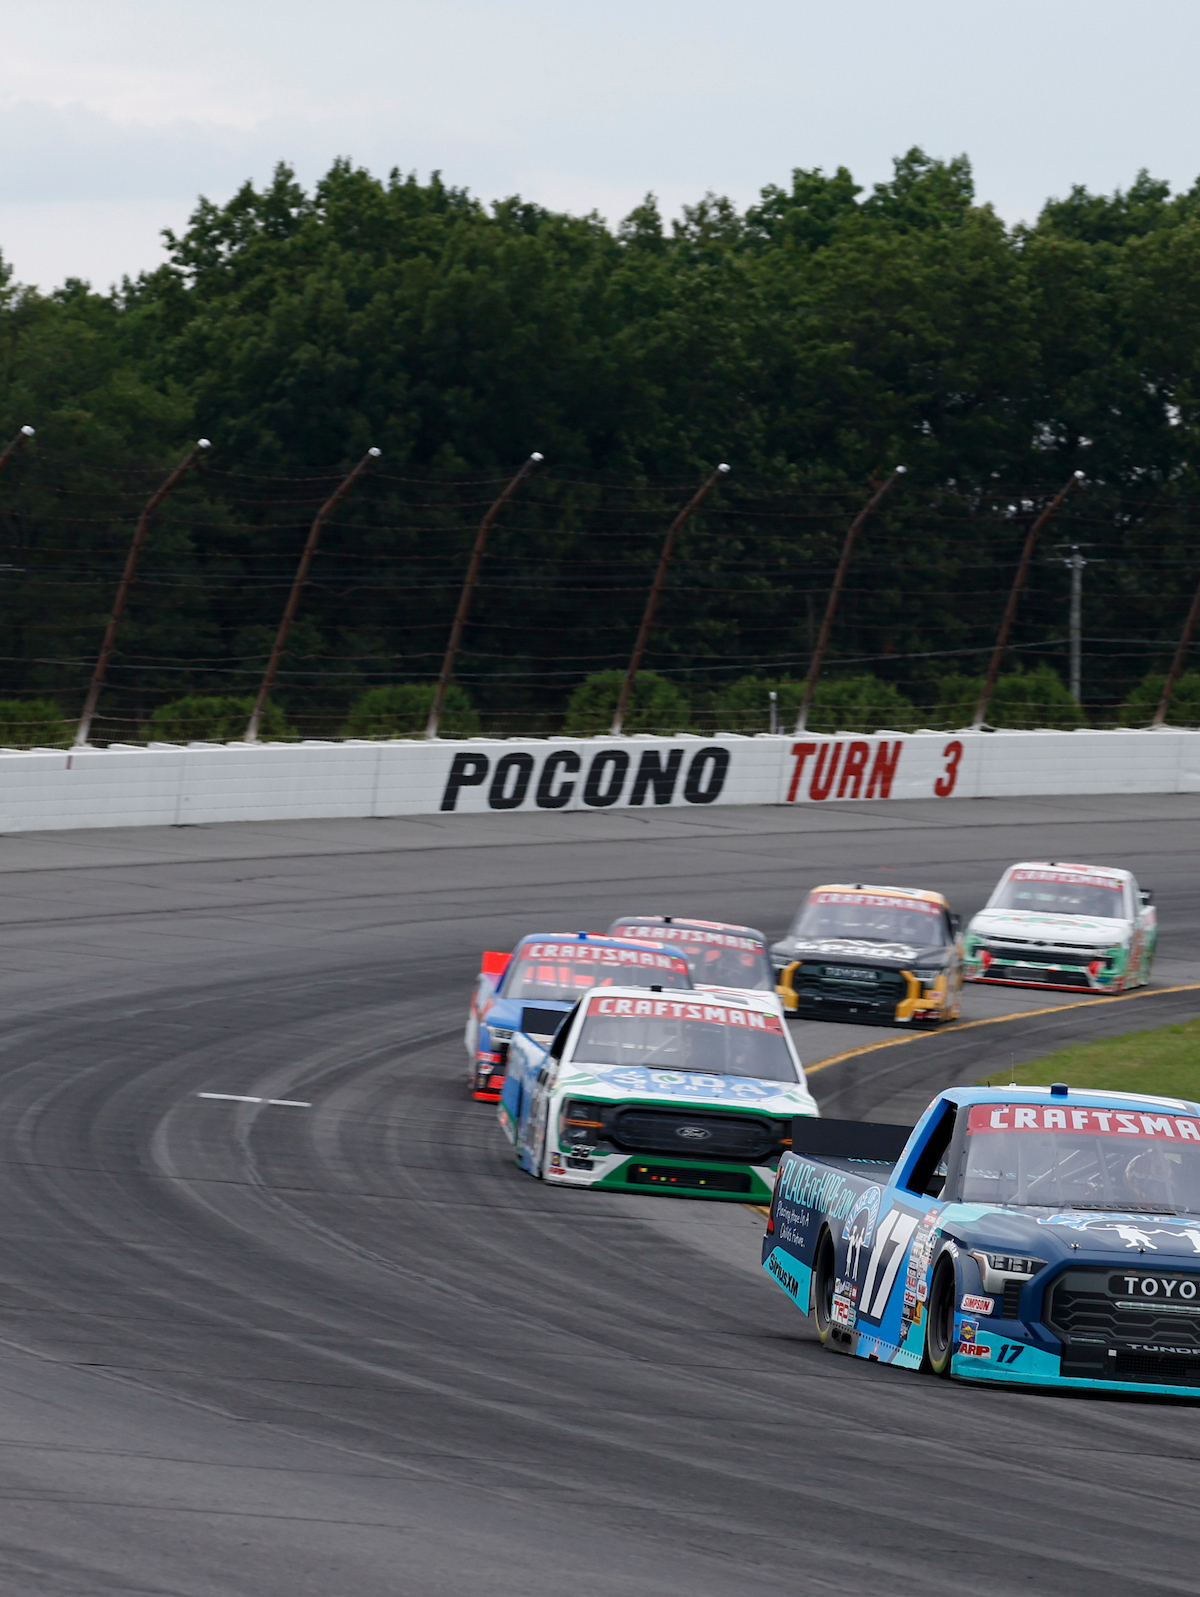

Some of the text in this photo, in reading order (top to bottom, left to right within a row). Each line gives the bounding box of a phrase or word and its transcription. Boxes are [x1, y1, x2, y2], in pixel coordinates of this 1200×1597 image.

[440, 740, 963, 811] POCONO TURN 3
[623, 926, 757, 951] CRAFTSMAN
[529, 943, 672, 969] CRAFTSMAN
[599, 998, 766, 1029] CRAFTSMAN
[769, 1253, 799, 1298] SiriusXM
[859, 1209, 919, 1320] 17
[963, 1297, 990, 1310] SIMPSON
[960, 1343, 990, 1356] ARP
[996, 1344, 1025, 1363] 17
